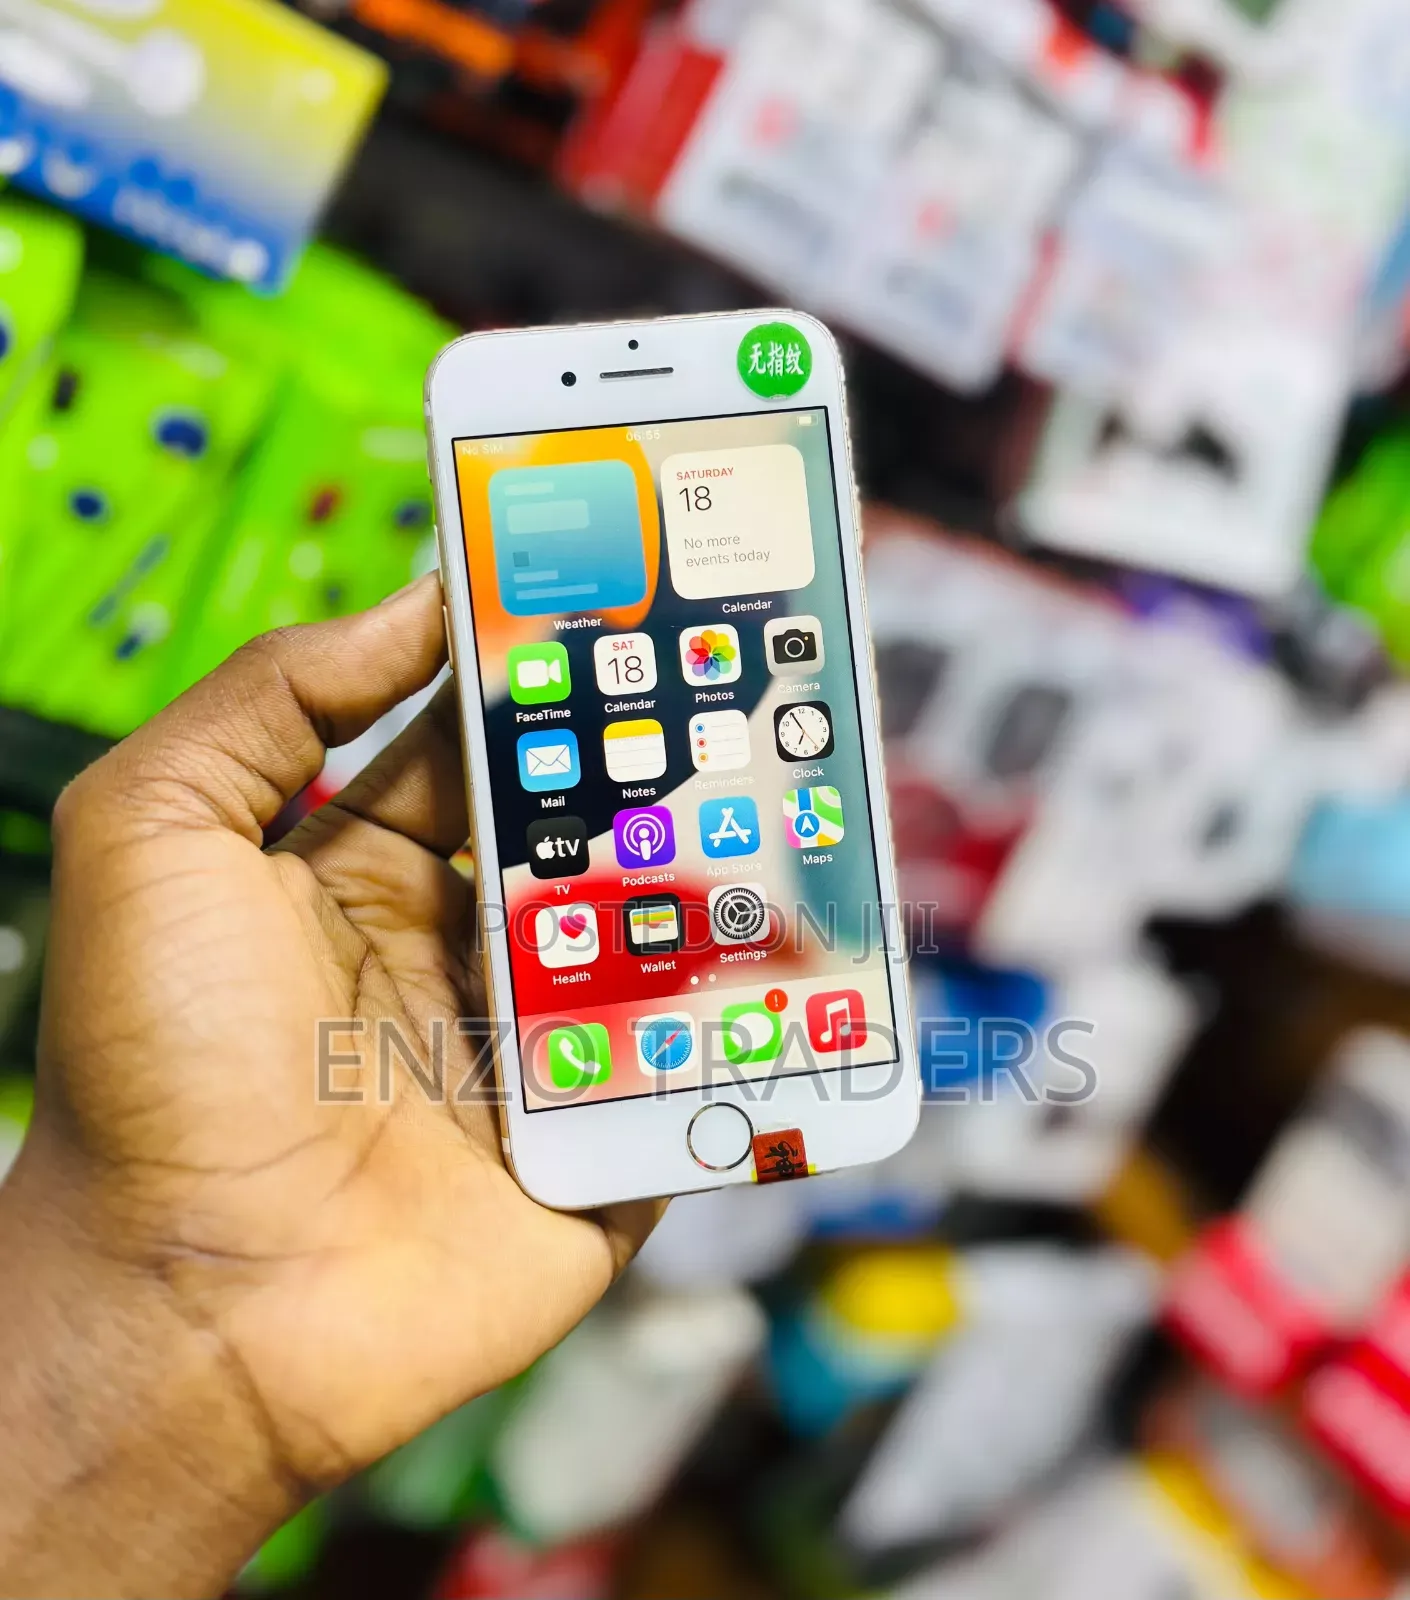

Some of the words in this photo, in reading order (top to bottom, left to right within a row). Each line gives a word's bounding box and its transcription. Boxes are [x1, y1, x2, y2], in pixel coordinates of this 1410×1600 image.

[747, 340, 805, 377] 无指纹
[676, 467, 734, 481] SATURDAY
[679, 485, 713, 512] 18
[684, 537, 703, 550] No
[707, 535, 741, 548] more
[686, 553, 730, 568] events
[734, 549, 771, 563] today
[722, 600, 773, 614] Calendar
[553, 617, 602, 630] Weather
[612, 640, 635, 651] SAT
[607, 655, 645, 685] 18
[777, 681, 821, 694] Camera
[695, 690, 735, 703] Photos
[604, 699, 656, 713] Calendar
[515, 708, 572, 723] FaceTime
[793, 766, 825, 779] Clock
[694, 775, 756, 790] Reminders
[622, 787, 657, 799] Notes
[541, 796, 566, 808] Mail
[555, 836, 580, 858] tv
[802, 853, 833, 866] Maps
[706, 866, 729, 879] App
[732, 861, 762, 874] Store
[622, 872, 675, 887] Podcasts
[554, 884, 571, 896] TV
[720, 950, 767, 964] Settings
[640, 960, 677, 973] Wallet
[552, 971, 591, 986] Health
